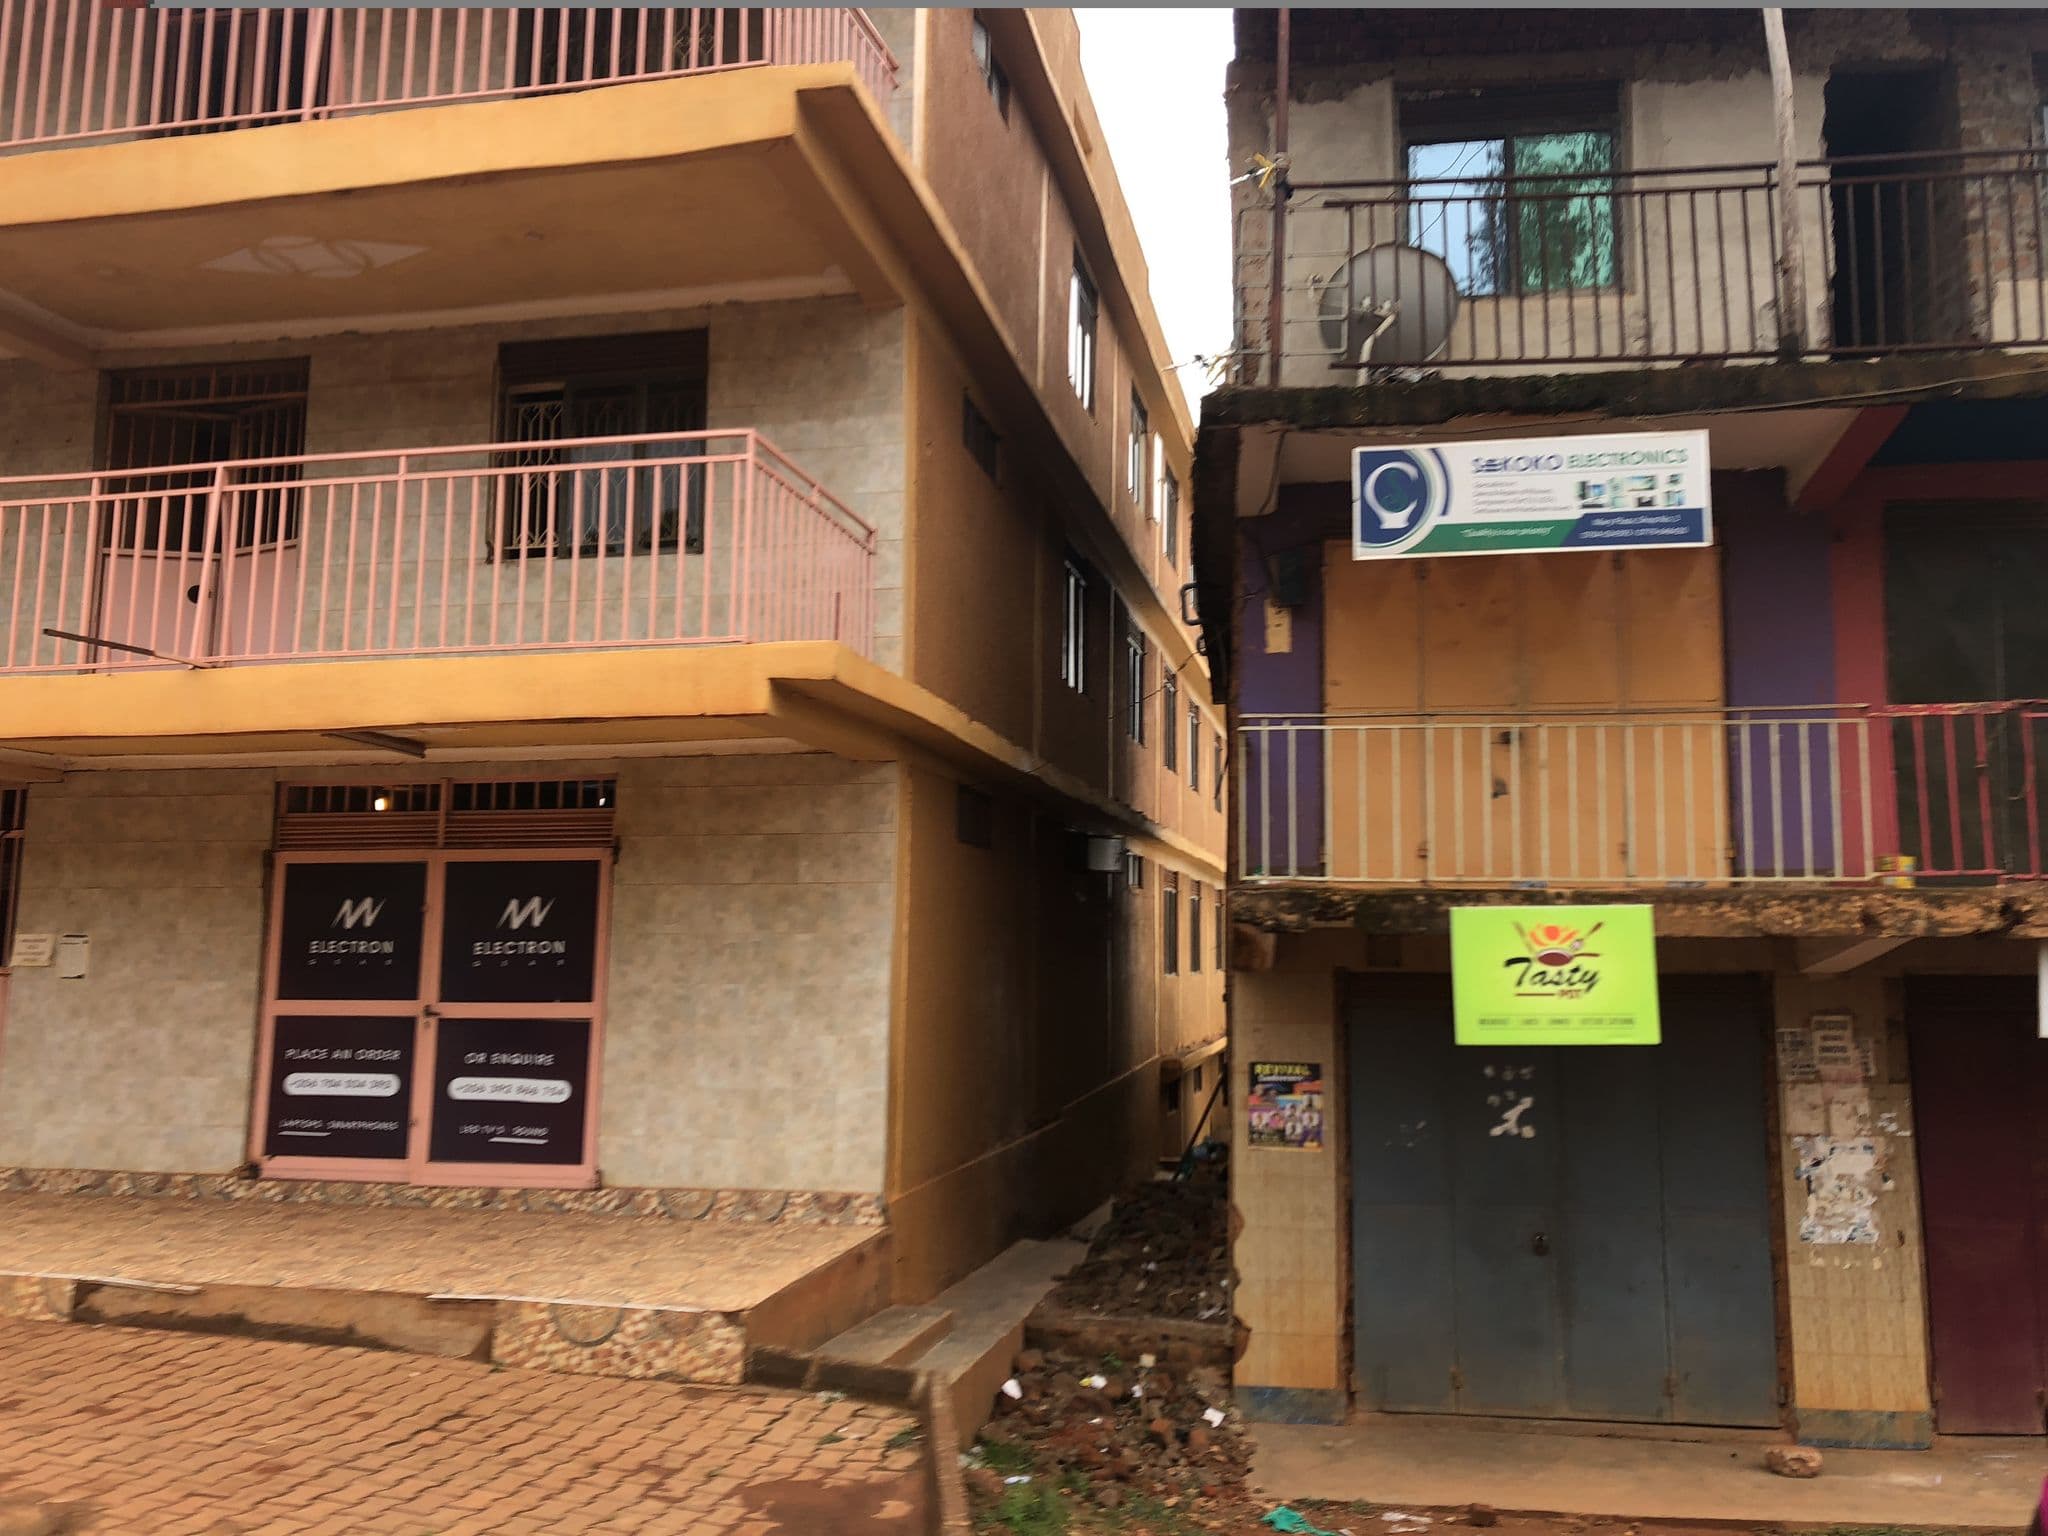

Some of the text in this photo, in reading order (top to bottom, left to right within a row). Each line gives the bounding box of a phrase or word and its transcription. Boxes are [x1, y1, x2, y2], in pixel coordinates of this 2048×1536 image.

[1567, 447, 1689, 469] ELECTRONICS
[308, 940, 395, 954] ELECTRON
[472, 940, 566, 955] ELECTRON
[1503, 955, 1600, 993] Tasty
[285, 1048, 401, 1061] PLACE AN ORDER
[464, 1052, 555, 1066] OR ENQUIRE
